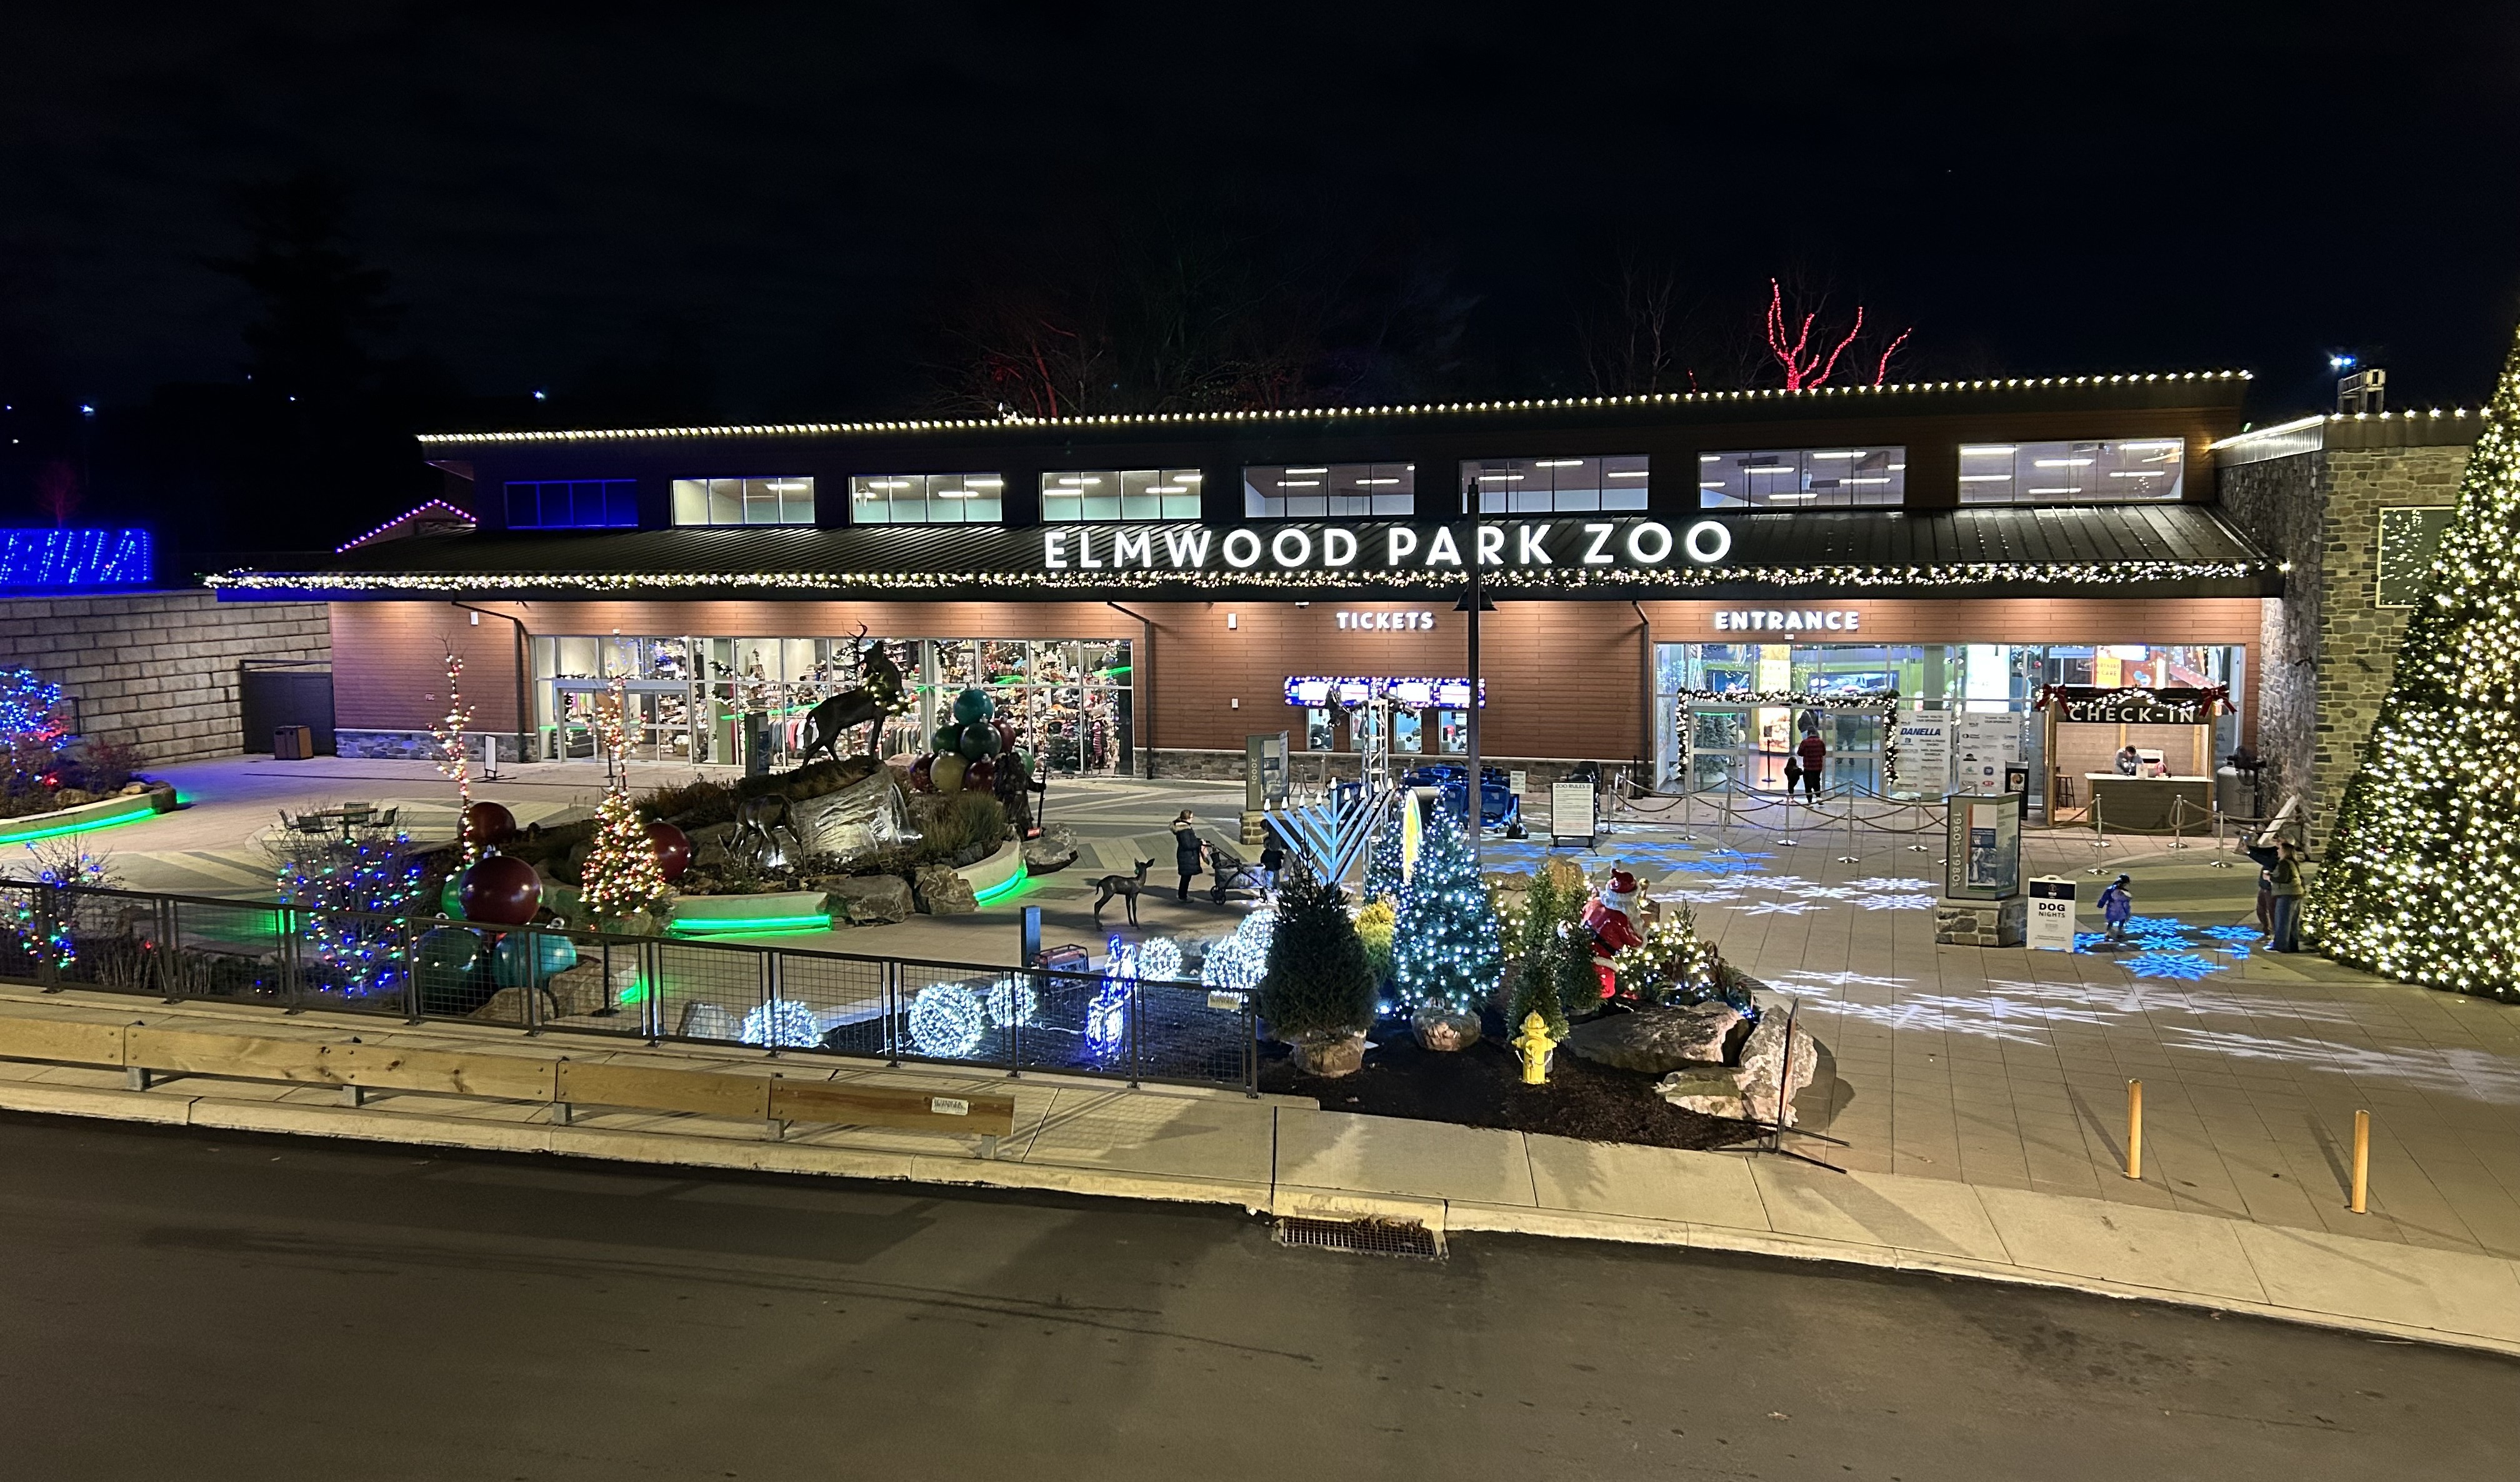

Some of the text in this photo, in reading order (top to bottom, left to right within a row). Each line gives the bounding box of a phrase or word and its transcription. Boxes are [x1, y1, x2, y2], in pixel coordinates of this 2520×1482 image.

[1045, 520, 1731, 568] ELMWOOD PARK ZOO
[1336, 611, 1434, 630] TICKETS
[1715, 610, 1860, 630] ENTRANCE
[2069, 707, 2194, 723] CHECK-IN
[1900, 728, 1941, 736] DANELLA
[2039, 902, 2066, 912] DOG
